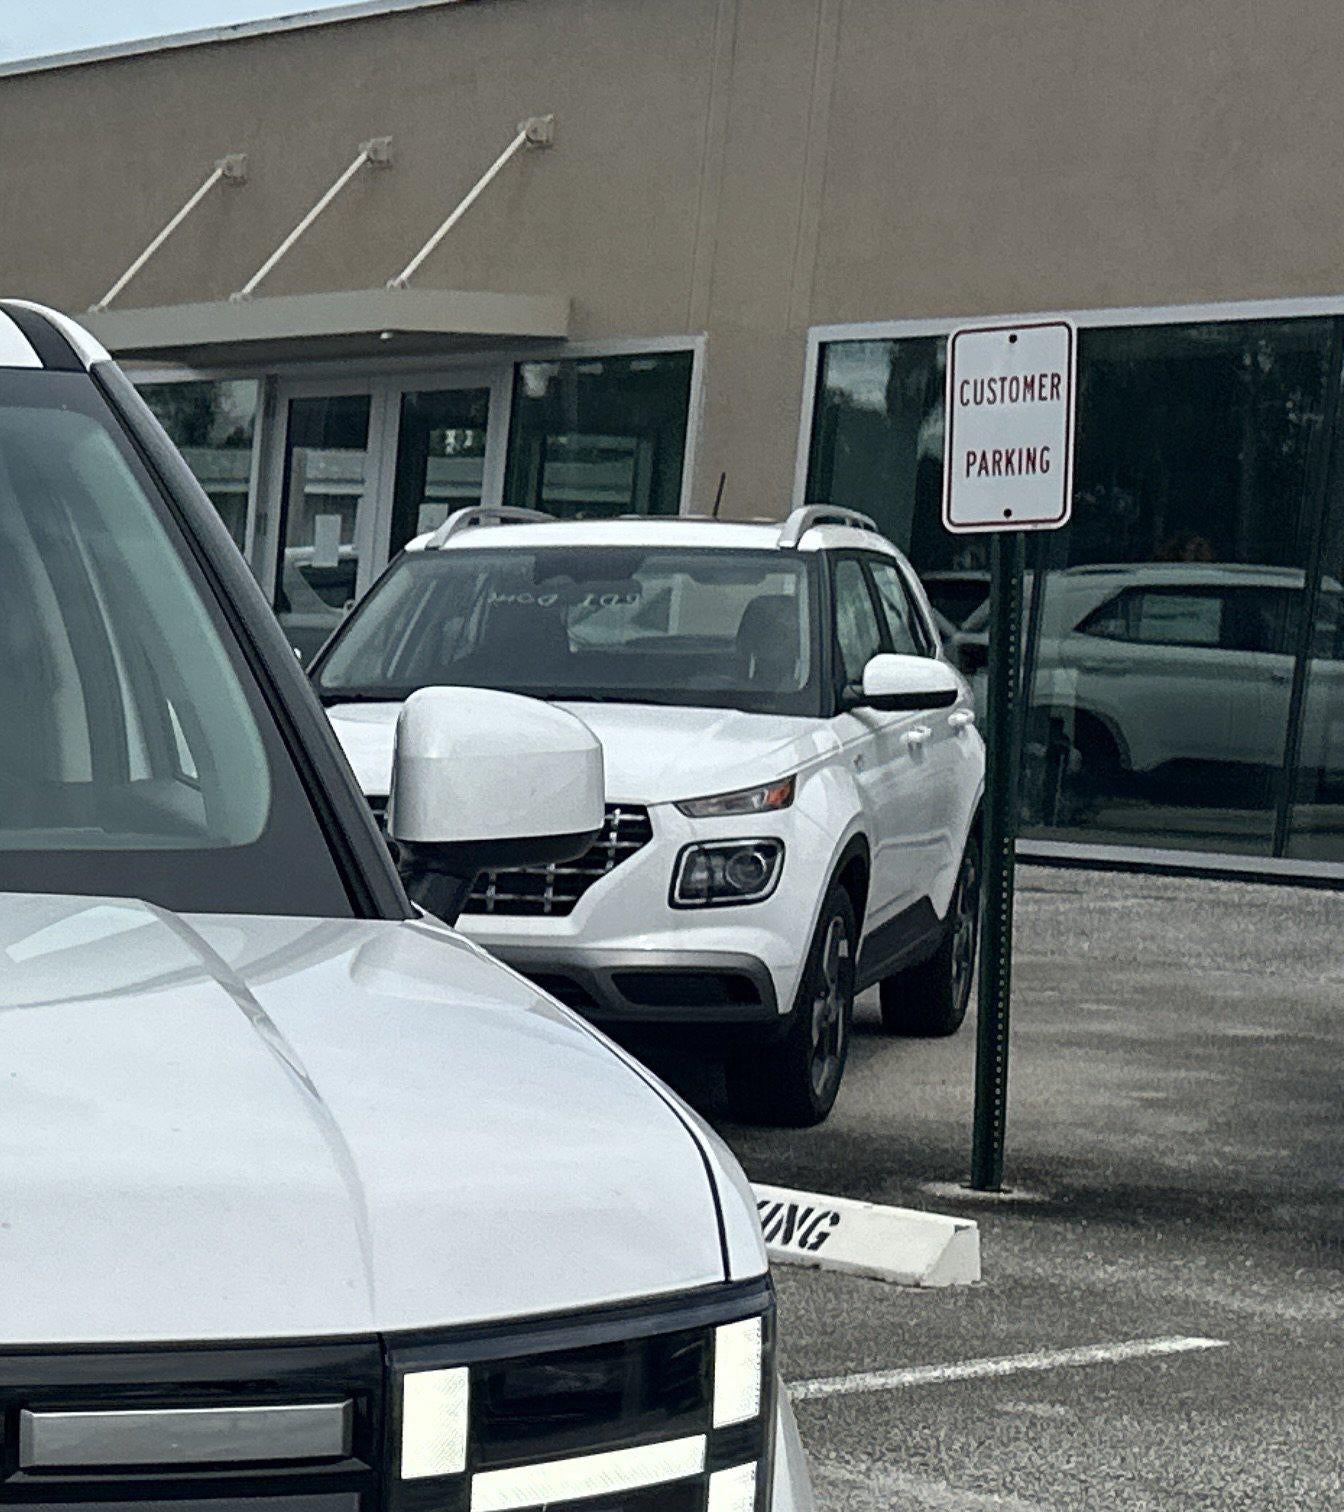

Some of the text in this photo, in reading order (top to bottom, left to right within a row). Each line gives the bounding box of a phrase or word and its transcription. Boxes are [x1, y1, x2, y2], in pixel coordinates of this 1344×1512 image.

[960, 372, 1062, 406] CUSTOMER
[965, 446, 1051, 478] PARKING
[756, 1200, 840, 1251] ING
